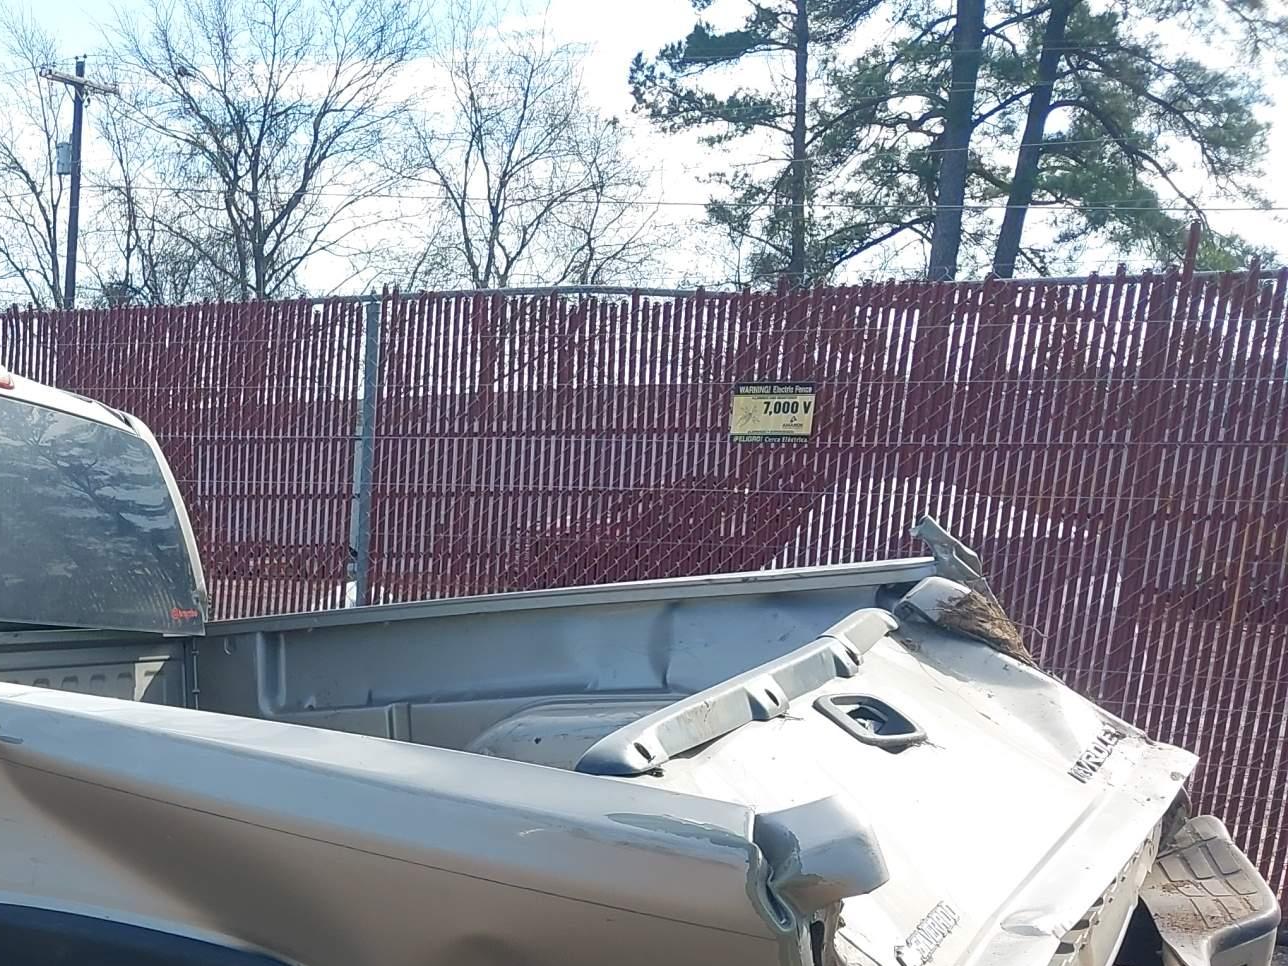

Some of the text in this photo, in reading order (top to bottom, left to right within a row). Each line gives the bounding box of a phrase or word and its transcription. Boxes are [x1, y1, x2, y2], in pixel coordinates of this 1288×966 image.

[739, 385, 812, 394] WARNING! Electric Fence
[763, 401, 811, 416] 7,000 V
